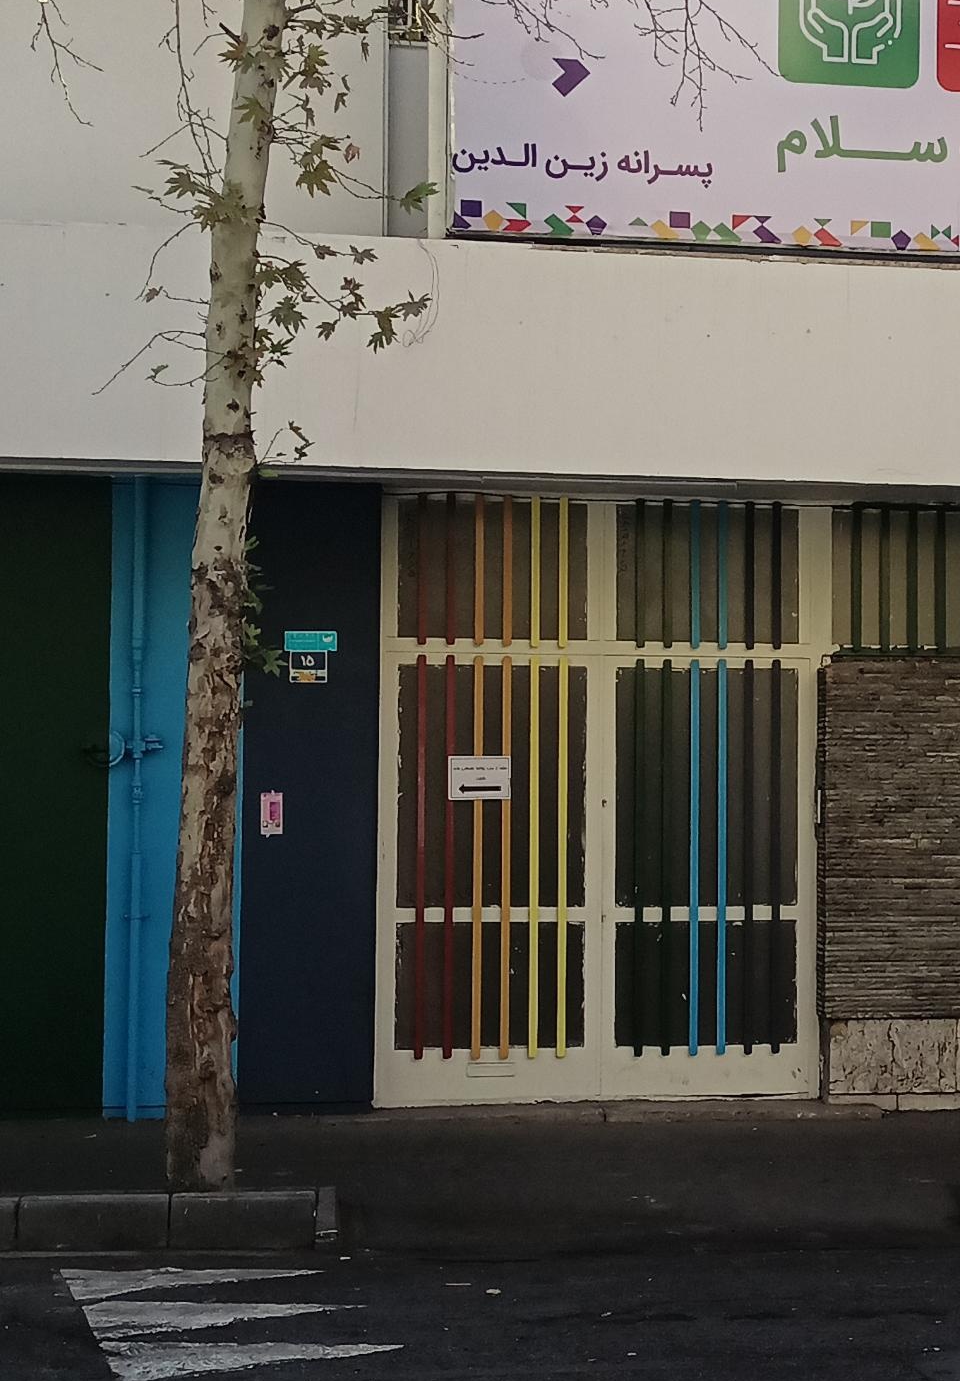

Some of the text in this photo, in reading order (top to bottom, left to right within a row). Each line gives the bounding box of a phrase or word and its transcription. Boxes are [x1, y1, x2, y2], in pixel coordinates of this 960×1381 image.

[451, 142, 713, 189] پسرانه زین الدین
[776, 114, 949, 174] سلام
